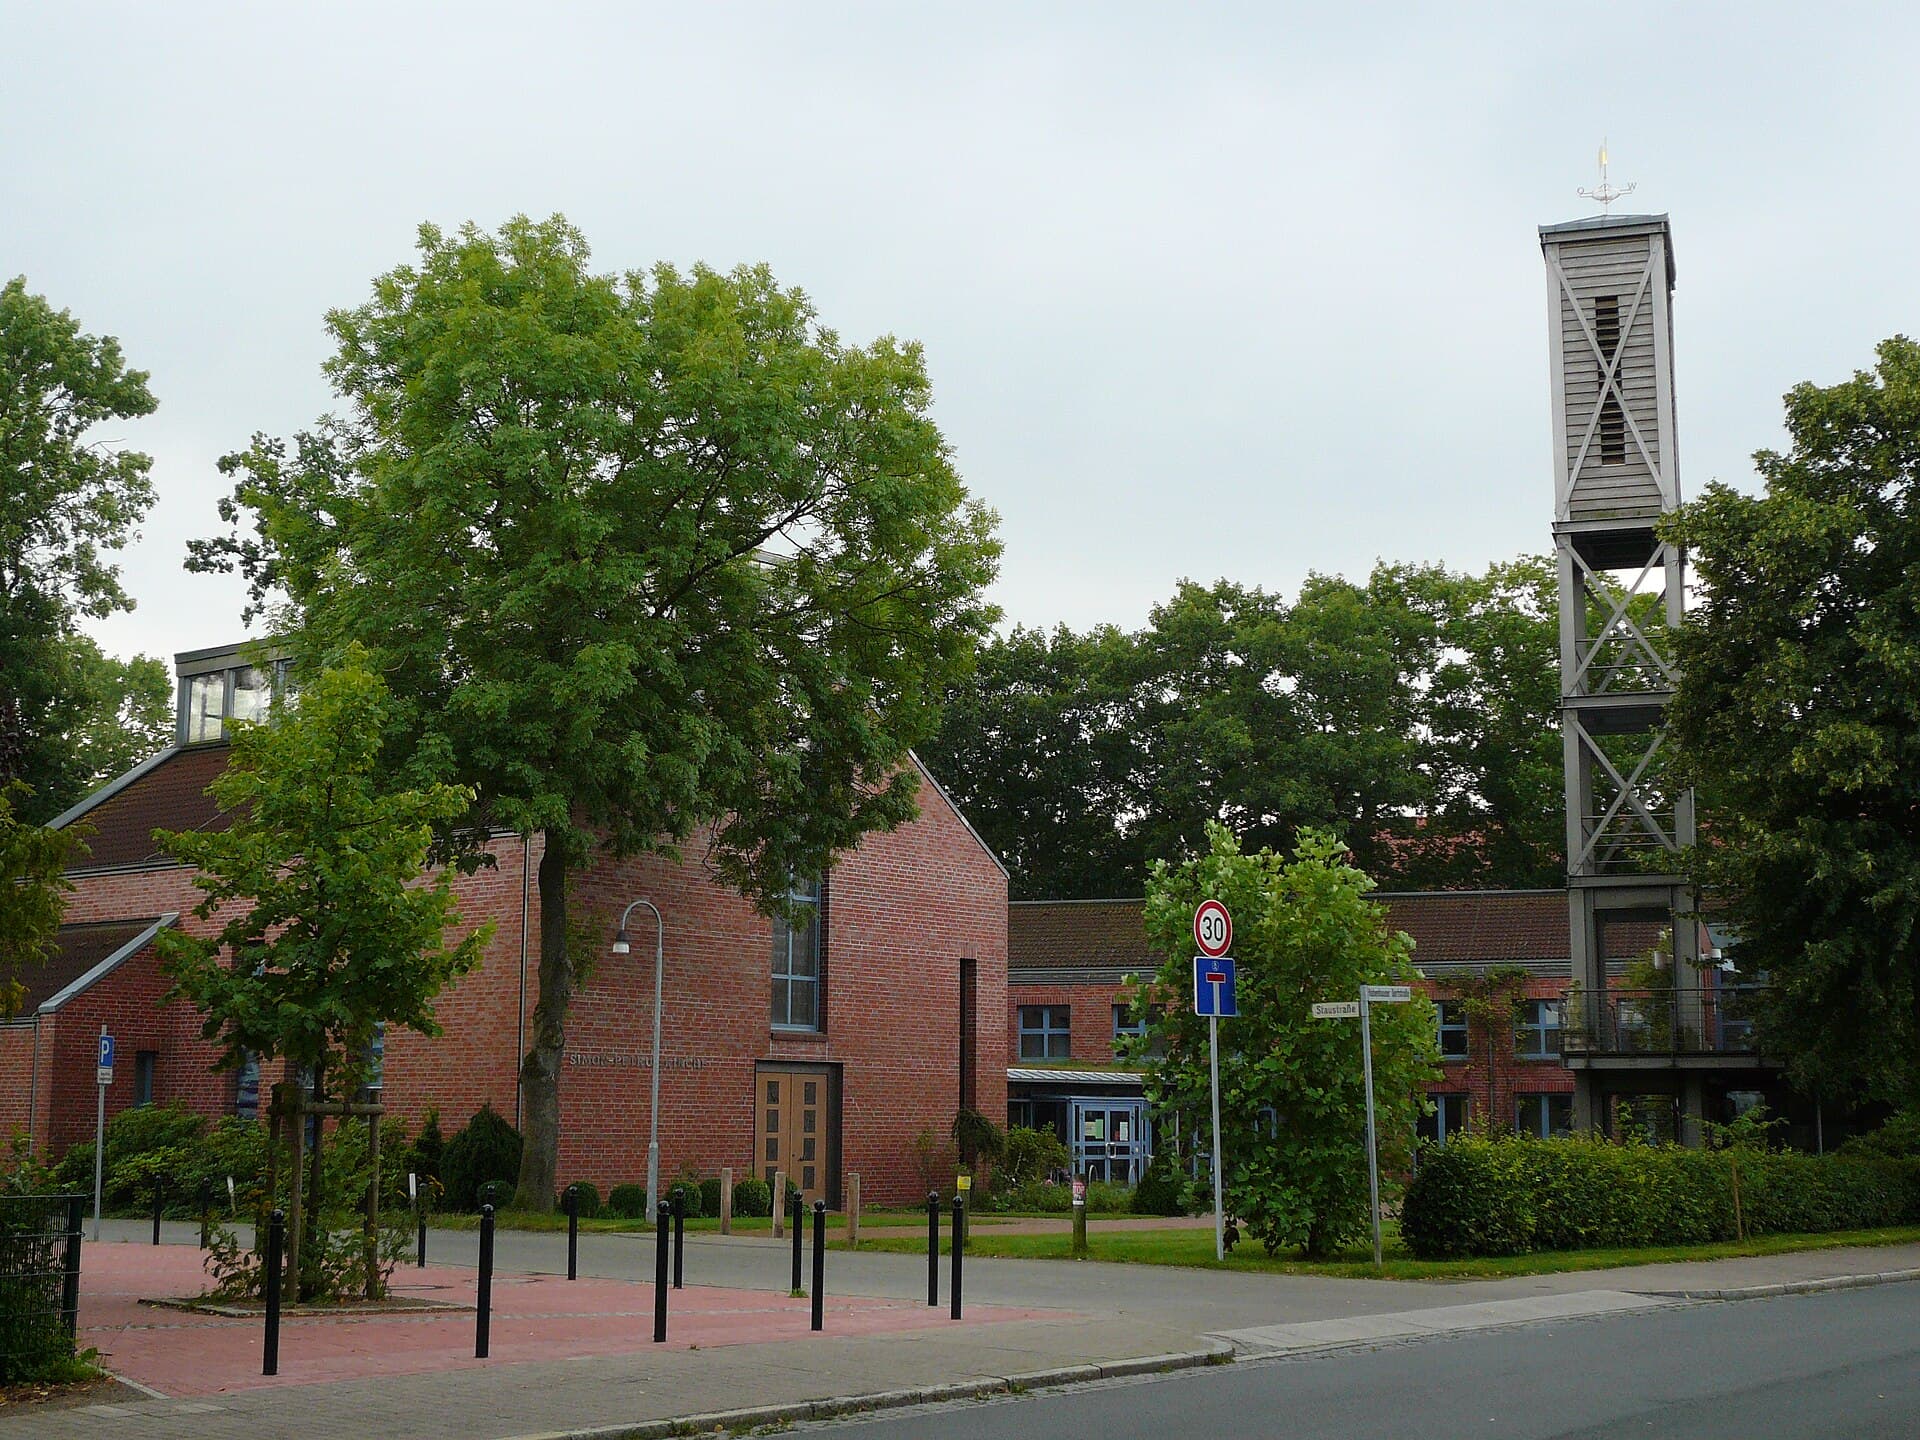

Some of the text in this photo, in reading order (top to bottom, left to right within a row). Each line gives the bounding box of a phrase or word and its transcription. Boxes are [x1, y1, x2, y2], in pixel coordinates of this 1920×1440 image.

[1202, 916, 1224, 942] 30
[1316, 1004, 1356, 1015] Staustraße
[101, 1039, 110, 1063] P
[570, 1053, 654, 1066] SIMON-PETRU
